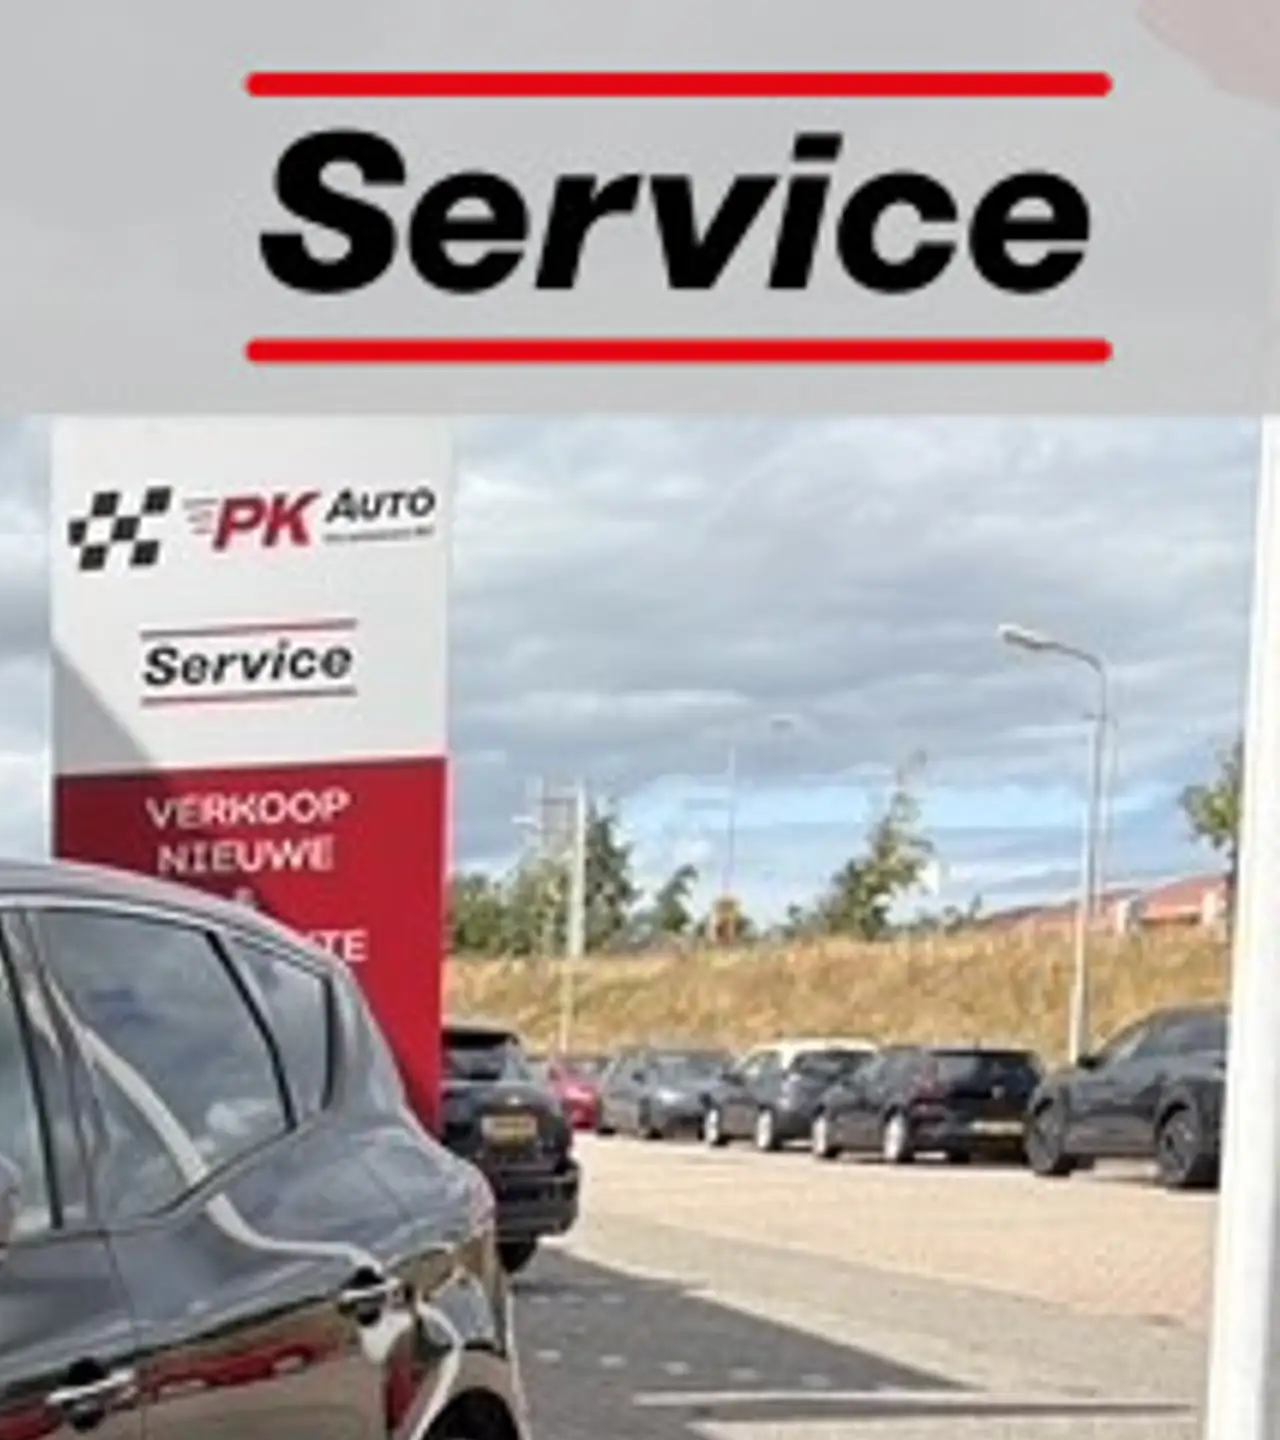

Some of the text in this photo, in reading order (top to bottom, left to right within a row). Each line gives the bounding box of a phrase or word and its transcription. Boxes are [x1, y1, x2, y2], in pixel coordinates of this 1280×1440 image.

[213, 490, 321, 551] PK
[143, 639, 354, 687] Service
[145, 788, 352, 830] VERKOOP
[156, 834, 334, 874] NIEUWE
